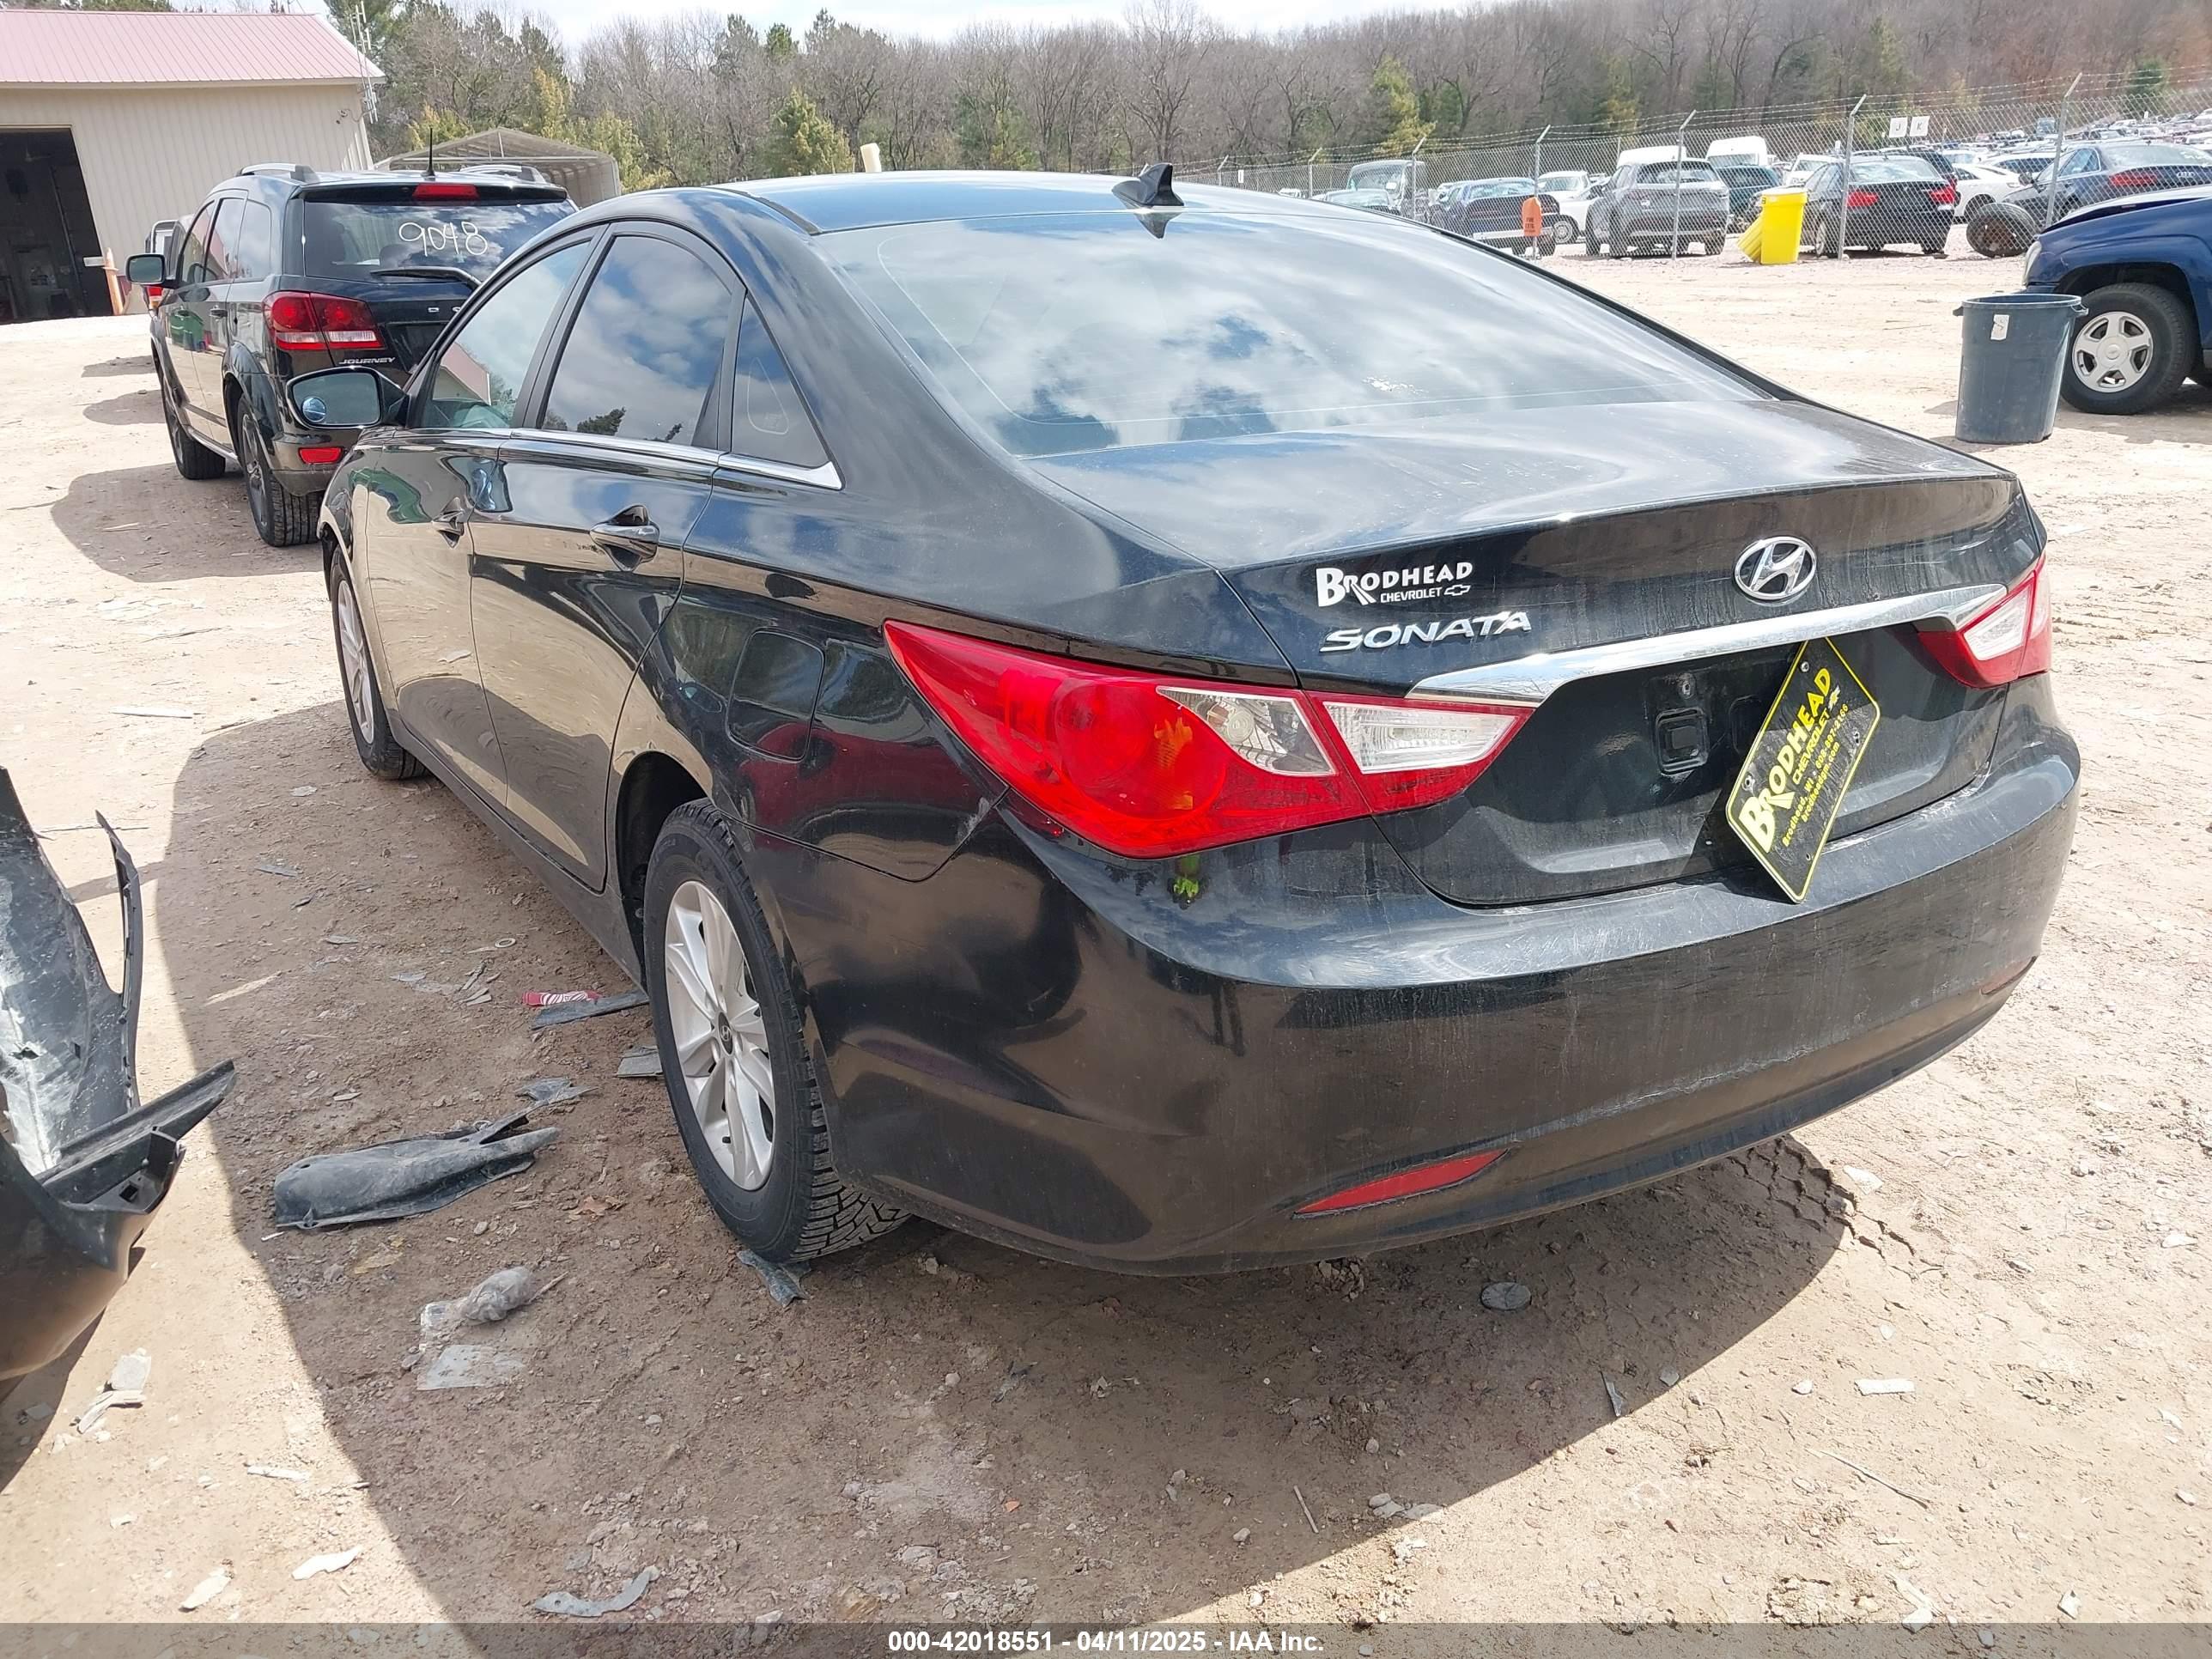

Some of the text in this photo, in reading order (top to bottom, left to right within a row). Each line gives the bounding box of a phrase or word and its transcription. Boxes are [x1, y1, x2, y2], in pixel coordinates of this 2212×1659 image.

[398, 221, 489, 257] 9048
[337, 356, 396, 365] JOURNEY
[1316, 562, 1474, 607] BRODHEAD
[1380, 586, 1443, 604] CHEVROLET
[1319, 611, 1532, 653] SONATA
[1739, 667, 1832, 854] BRODHEAD
[1792, 708, 1830, 785] CHEVROLET
[1804, 777, 1814, 793] WI
